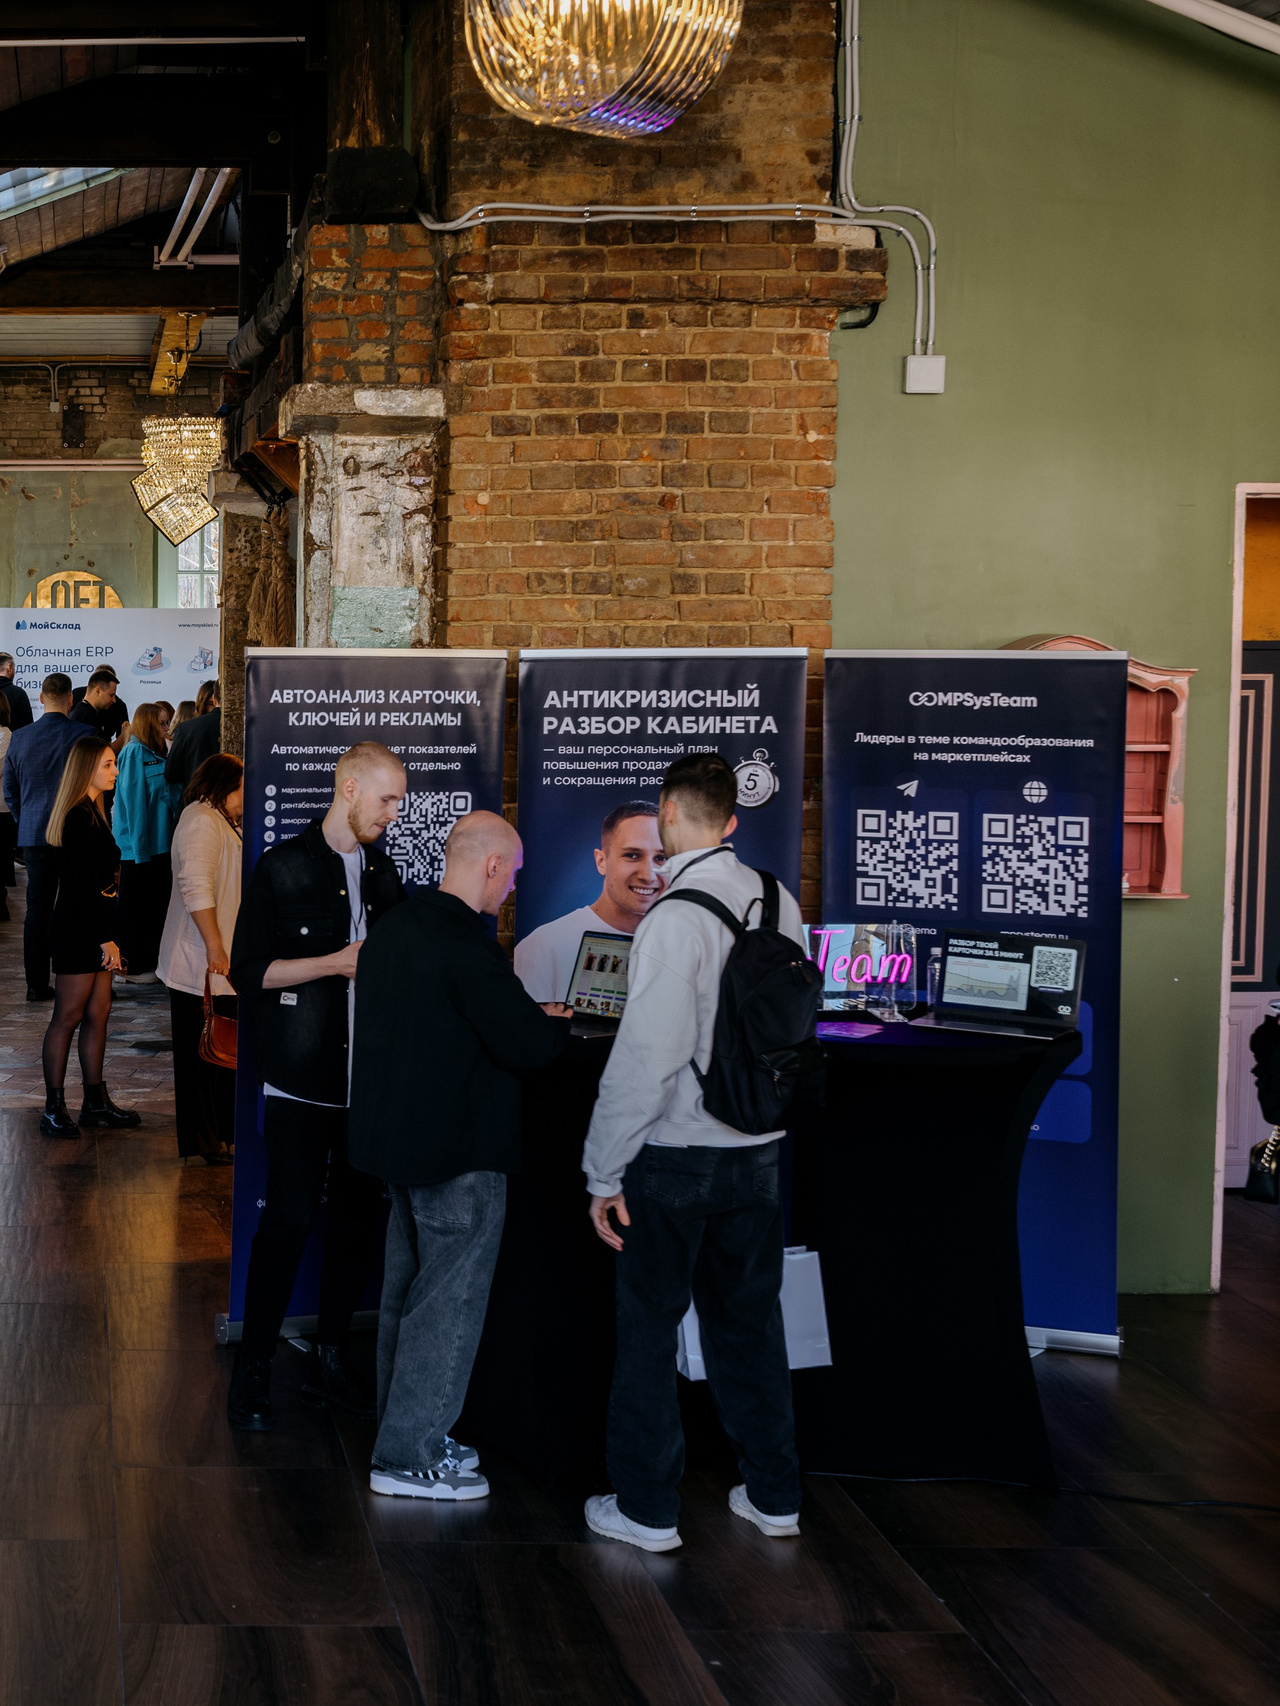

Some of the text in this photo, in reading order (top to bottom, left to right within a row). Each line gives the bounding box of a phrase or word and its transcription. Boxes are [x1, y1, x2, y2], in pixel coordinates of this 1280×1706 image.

[29, 620, 81, 631] МойСклад
[15, 646, 114, 658] Облачная ERP
[15, 664, 95, 675] для вашего
[270, 689, 481, 707] АВТОАНАЛИЗ КАРТОЧКИ,
[543, 683, 760, 708] АНТИКРИЗИСНЫЙ
[288, 708, 462, 727] КЛЮЧЕЙ И РЕКЛАМЫ
[543, 715, 779, 735] РАЗБОР КАБИНЕТА
[853, 732, 1095, 749] Лидеры в теме командообразования
[408, 743, 478, 755] показателей
[558, 744, 585, 755] ваш
[588, 743, 684, 757] персональный
[687, 744, 719, 754] план
[913, 750, 1031, 765] на маркетплейсах
[285, 762, 300, 771] по
[408, 762, 461, 772] отдельно
[543, 761, 672, 772] повышения продаж
[543, 776, 551, 786] и
[553, 776, 637, 788] сокращения
[744, 772, 760, 791] 5
[281, 787, 332, 795] маржинальная
[737, 788, 760, 799] МИНУТ
[948, 938, 999, 949] РАЗБОР ТВОЕЙ
[947, 946, 1025, 960] КАРТОЧКИ ЗА 5 МИНУТ
